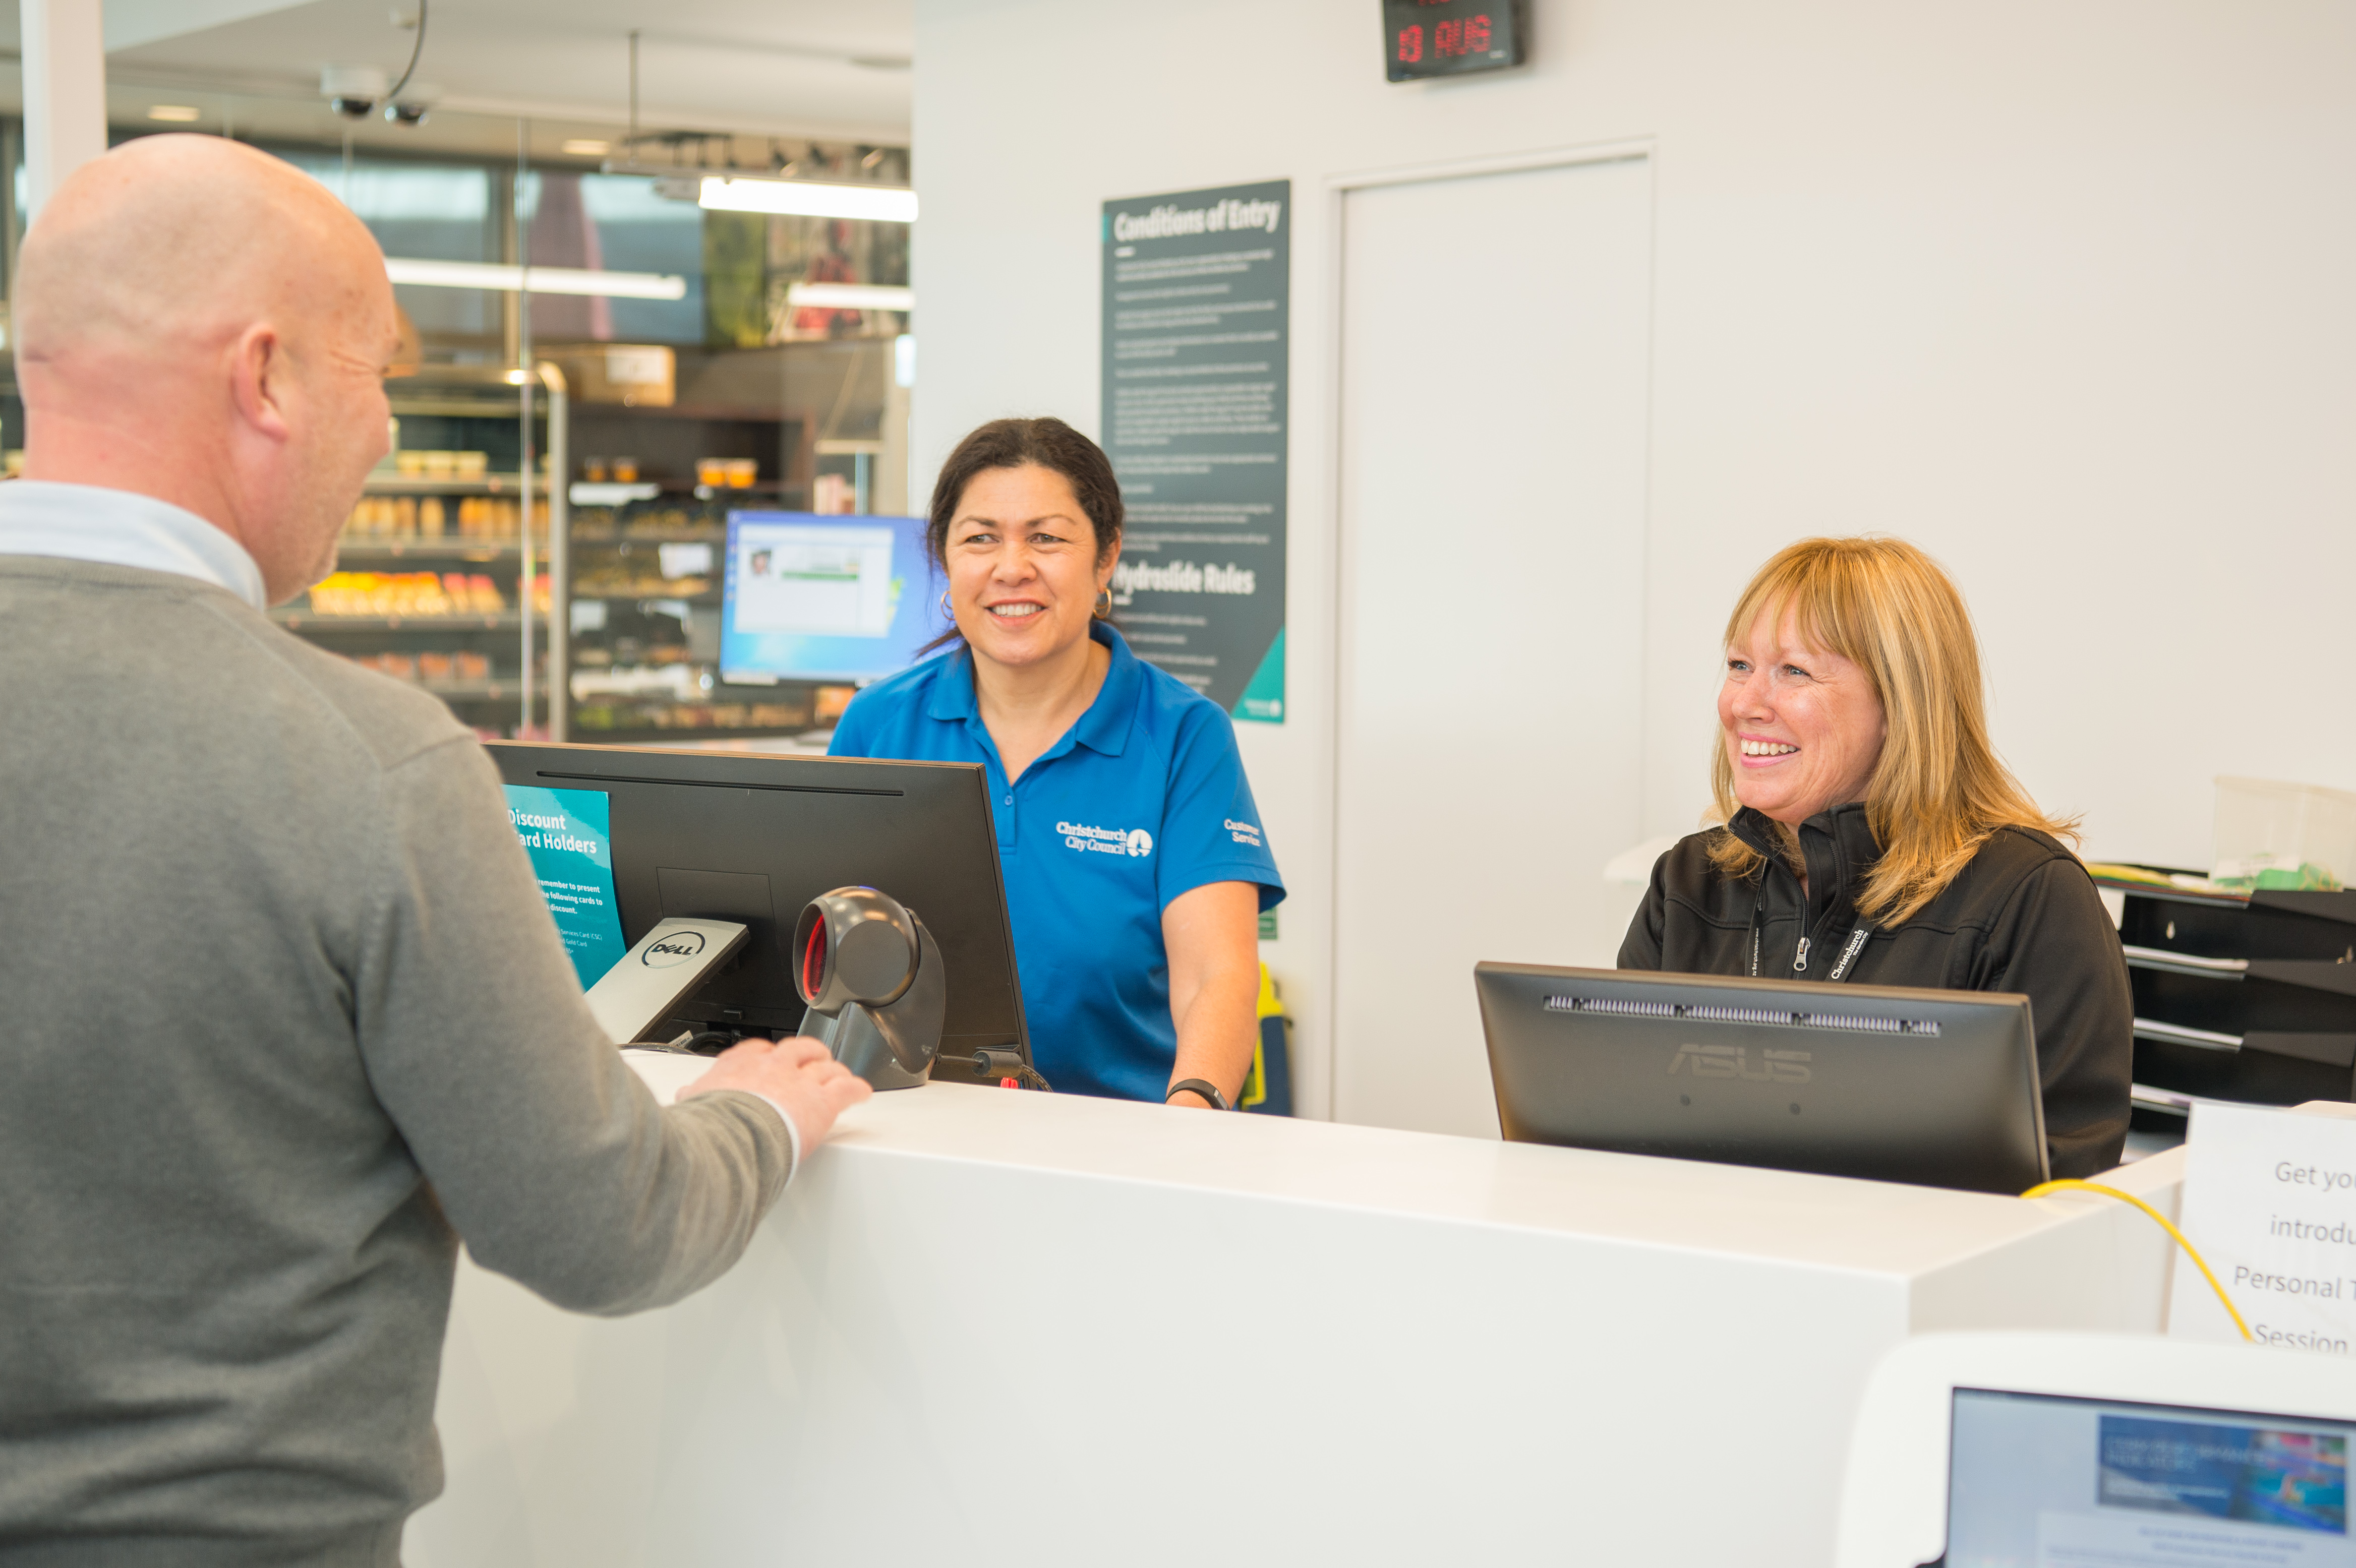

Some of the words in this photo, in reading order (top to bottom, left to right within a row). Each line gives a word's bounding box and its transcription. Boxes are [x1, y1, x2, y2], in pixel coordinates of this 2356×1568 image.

[1435, 14, 1491, 58] AUG
[1114, 203, 1206, 242] Conditions
[1207, 198, 1227, 231] of
[1228, 198, 1281, 233] Entry
[1112, 560, 1202, 595] Hydroslide
[1203, 562, 1255, 595] Rules
[507, 808, 566, 830] Discount
[1224, 818, 1259, 835] Customer
[515, 830, 541, 848] ard
[543, 833, 597, 854] Holders
[1056, 821, 1128, 842] Christchurch
[1232, 831, 1260, 847] Service
[1065, 835, 1087, 852] City
[1087, 838, 1126, 855] Council
[538, 879, 568, 889] remember
[577, 884, 600, 893] present
[550, 891, 578, 904] following
[550, 904, 577, 914] discount.
[561, 929, 578, 937] Services
[1856, 938, 1865, 950] Garden
[651, 944, 693, 956] DELL
[1831, 929, 1864, 979] Christchurch
[1667, 1044, 1811, 1083] ASUS
[2275, 1162, 2317, 1185] Get
[2321, 1171, 2356, 1192] yo
[2271, 1214, 2356, 1245] introdu
[2234, 1265, 2341, 1299] Personal
[2253, 1323, 2348, 1354] Session
